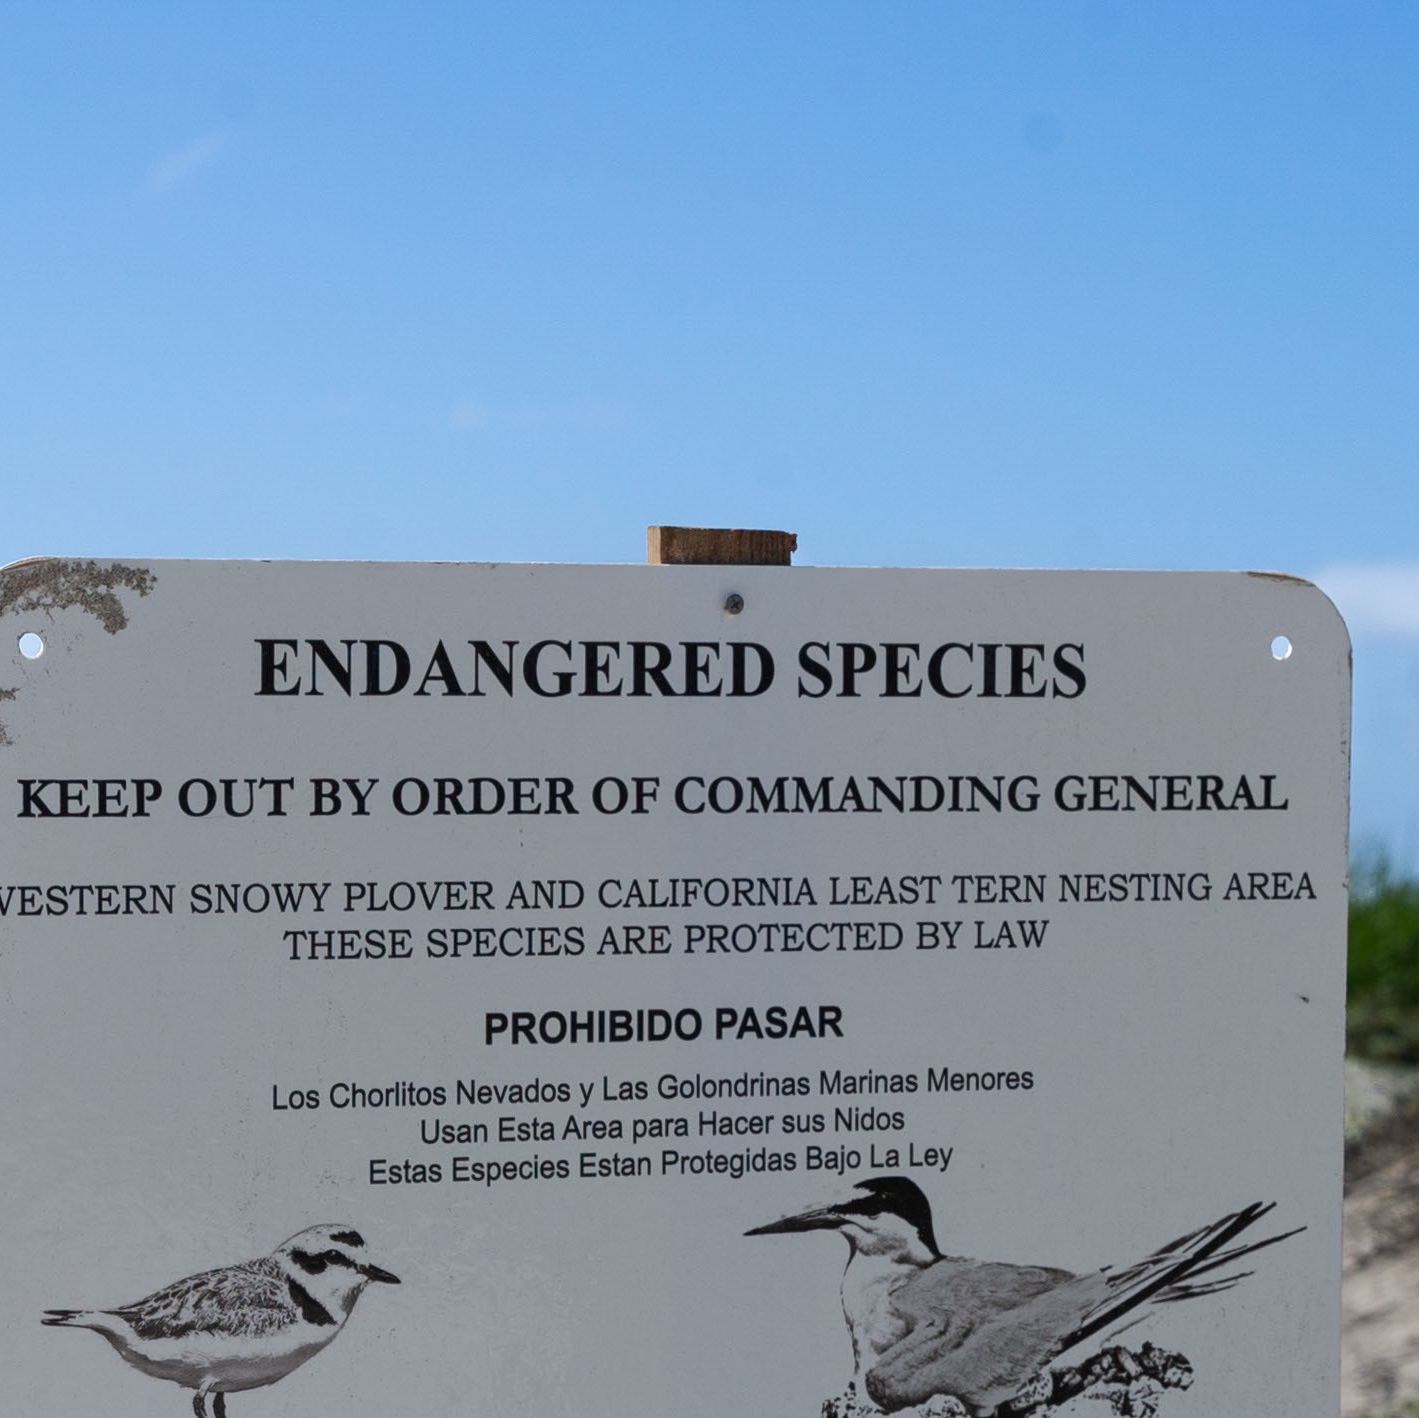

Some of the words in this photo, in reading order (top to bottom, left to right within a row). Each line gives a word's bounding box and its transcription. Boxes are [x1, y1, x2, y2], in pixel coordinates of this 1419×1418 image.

[253, 638, 775, 698] ENDANGERED
[797, 641, 1087, 699] SPECIES
[16, 778, 163, 818] KEEP
[178, 776, 295, 818] OUT
[309, 778, 380, 817] BY
[392, 777, 580, 816] ORDER
[592, 776, 660, 815] OF
[674, 775, 1041, 815] COMMANDING
[1054, 774, 1289, 812] GENERAL
[190, 882, 332, 914] SNOWY
[343, 880, 496, 912] PLOVER
[505, 879, 585, 910] AND
[598, 877, 818, 909] CALIFORNIA
[829, 875, 943, 906] LEAST
[951, 874, 1047, 904] TERN
[1058, 872, 1213, 903] NESTING
[1222, 871, 1317, 901] AREA
[282, 929, 414, 961] THESE
[426, 926, 586, 959] SPECIES
[596, 925, 673, 956] ARE
[684, 921, 904, 954] PROTECTED
[915, 921, 963, 950] BY
[974, 919, 1050, 949] LAW
[485, 1007, 703, 1046] PROHIBIDO
[715, 1005, 844, 1041] PASAR
[272, 1084, 320, 1111] Los
[329, 1081, 447, 1109] Chorlitos
[456, 1077, 571, 1106] Nevados
[579, 1082, 595, 1109] y
[603, 1075, 649, 1101] Las
[657, 1071, 811, 1100] Golondrinas
[819, 1069, 919, 1095] Marinas
[927, 1067, 1034, 1093] Menores
[421, 1118, 488, 1145] Usan
[498, 1116, 555, 1143] Esta
[561, 1114, 623, 1141] Area
[632, 1117, 689, 1145] para
[698, 1110, 775, 1137] Hacer
[781, 1113, 826, 1134] sus
[834, 1106, 905, 1132] Nidos
[369, 1159, 443, 1185] Estas
[452, 1154, 570, 1188] Especies
[579, 1152, 652, 1178] Estan
[661, 1147, 797, 1180] Protegidas
[806, 1144, 862, 1176] Bajo
[870, 1143, 900, 1169] La
[909, 1142, 954, 1173] Ley
